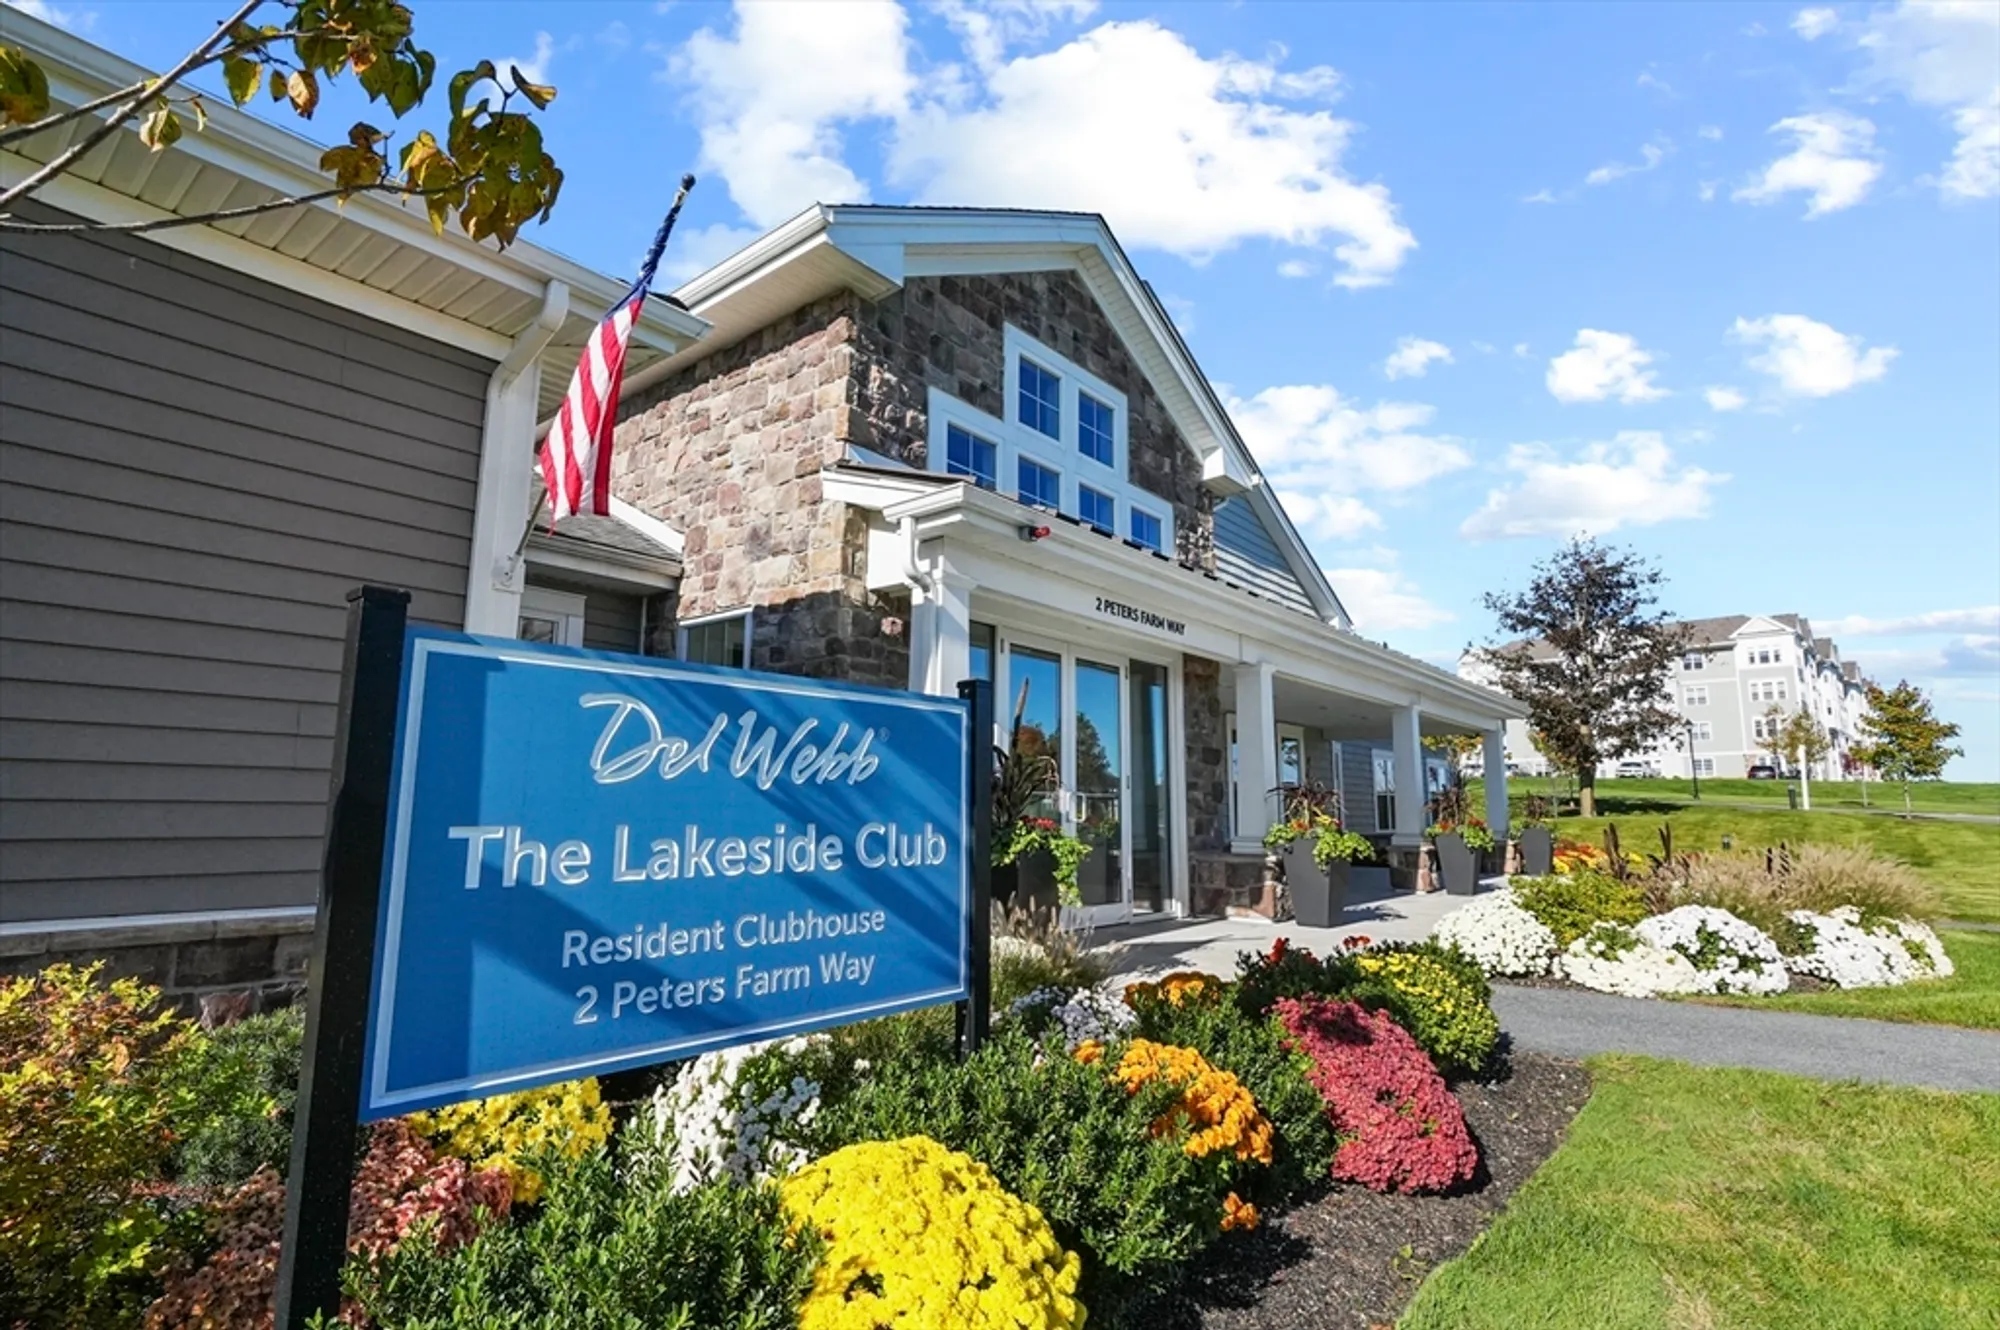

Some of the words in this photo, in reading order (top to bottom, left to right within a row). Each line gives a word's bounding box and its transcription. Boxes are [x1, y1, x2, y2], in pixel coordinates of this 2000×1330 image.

[1095, 597, 1103, 613] 2
[1104, 600, 1139, 622] PETERS
[1141, 611, 1165, 630] FARM
[1167, 619, 1185, 635] WAY
[579, 692, 728, 785] Del
[728, 709, 880, 790] Webb
[447, 825, 592, 890] The
[611, 822, 844, 883] Lakeside
[854, 821, 948, 870] Club
[561, 920, 726, 969] Resident
[733, 907, 887, 950] Clubhouse
[572, 985, 599, 1026] 2
[611, 974, 726, 1018] Peters
[734, 961, 811, 1000] Farm
[817, 950, 877, 989] Way
